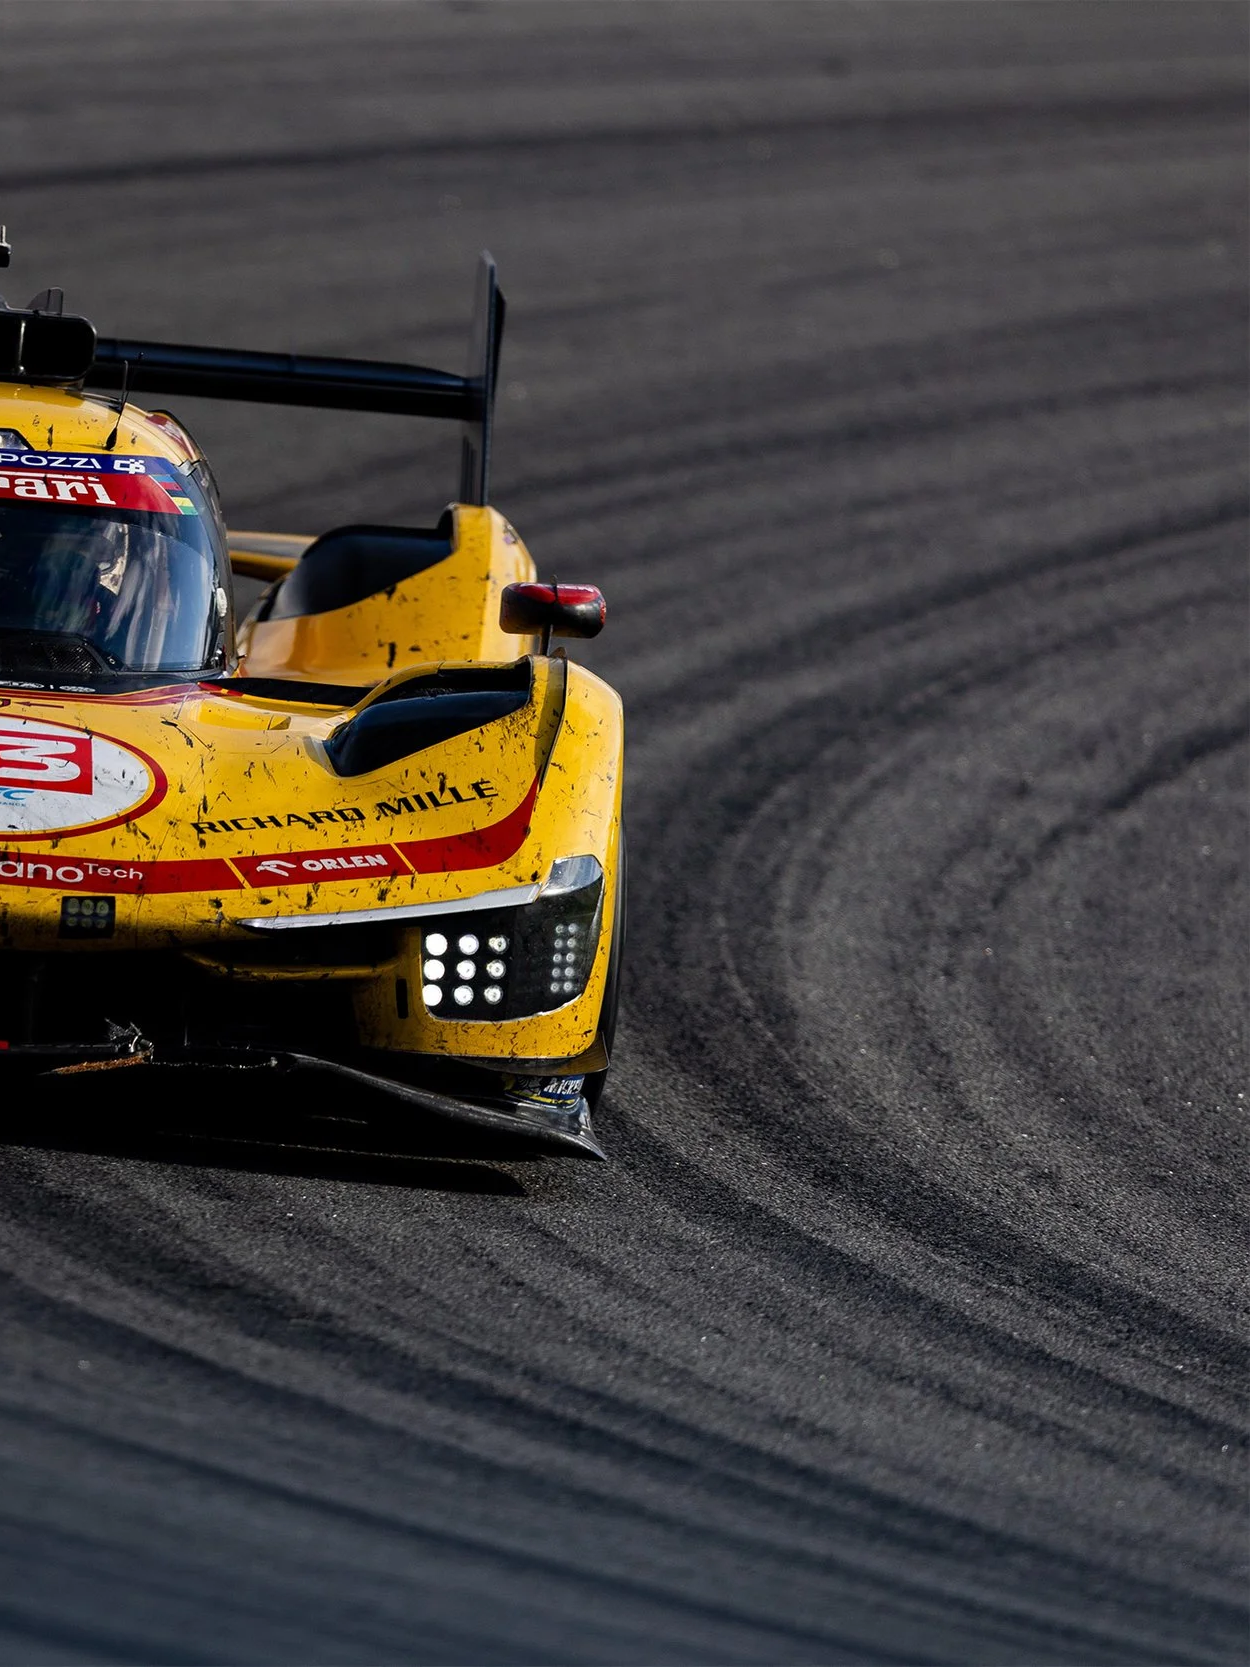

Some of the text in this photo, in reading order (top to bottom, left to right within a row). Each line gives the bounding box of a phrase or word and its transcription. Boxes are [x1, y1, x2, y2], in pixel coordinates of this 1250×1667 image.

[191, 780, 499, 835] RICHARD MILLE
[301, 854, 388, 872] ORLEN
